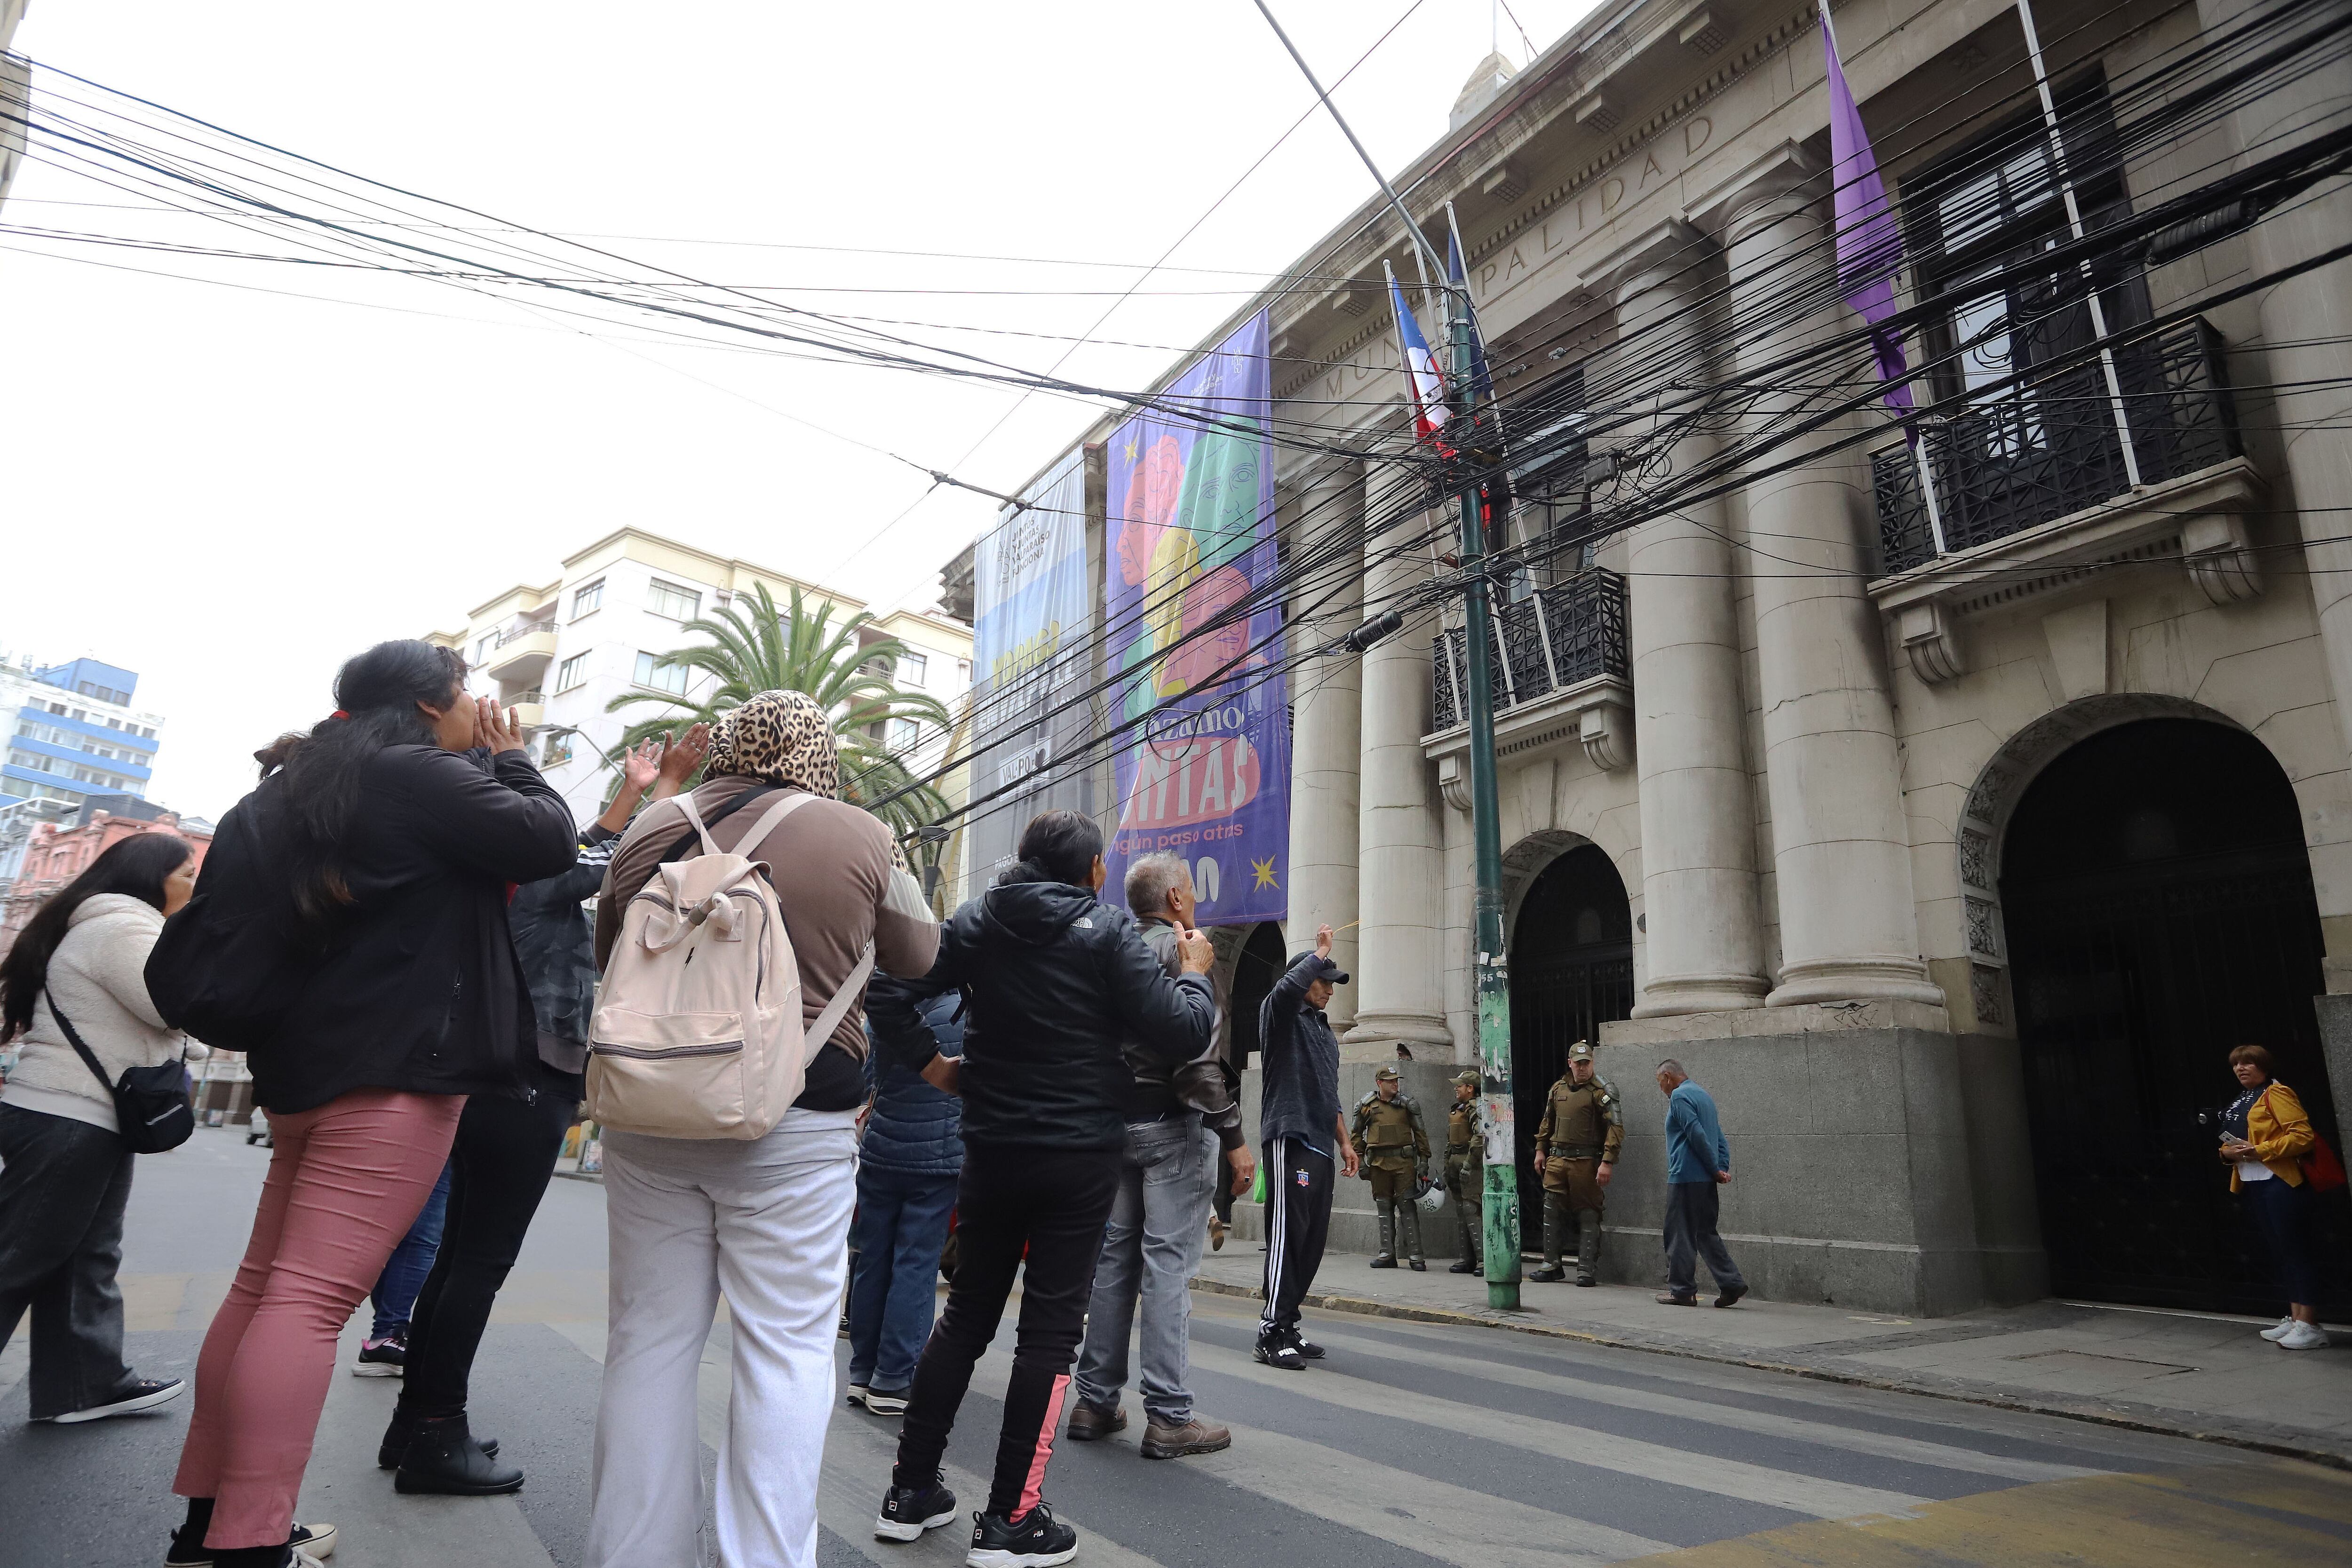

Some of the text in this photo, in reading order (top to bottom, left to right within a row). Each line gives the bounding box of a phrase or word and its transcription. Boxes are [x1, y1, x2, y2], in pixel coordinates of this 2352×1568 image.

[1326, 115, 1713, 400] MUNPALIDAD
[1122, 734, 1248, 822] NTAS
[1157, 831, 1199, 851] paso
[995, 854, 1012, 870] PAGO
[1278, 1347, 1299, 1357] PUM
[1033, 1529, 1044, 1538] FILA
